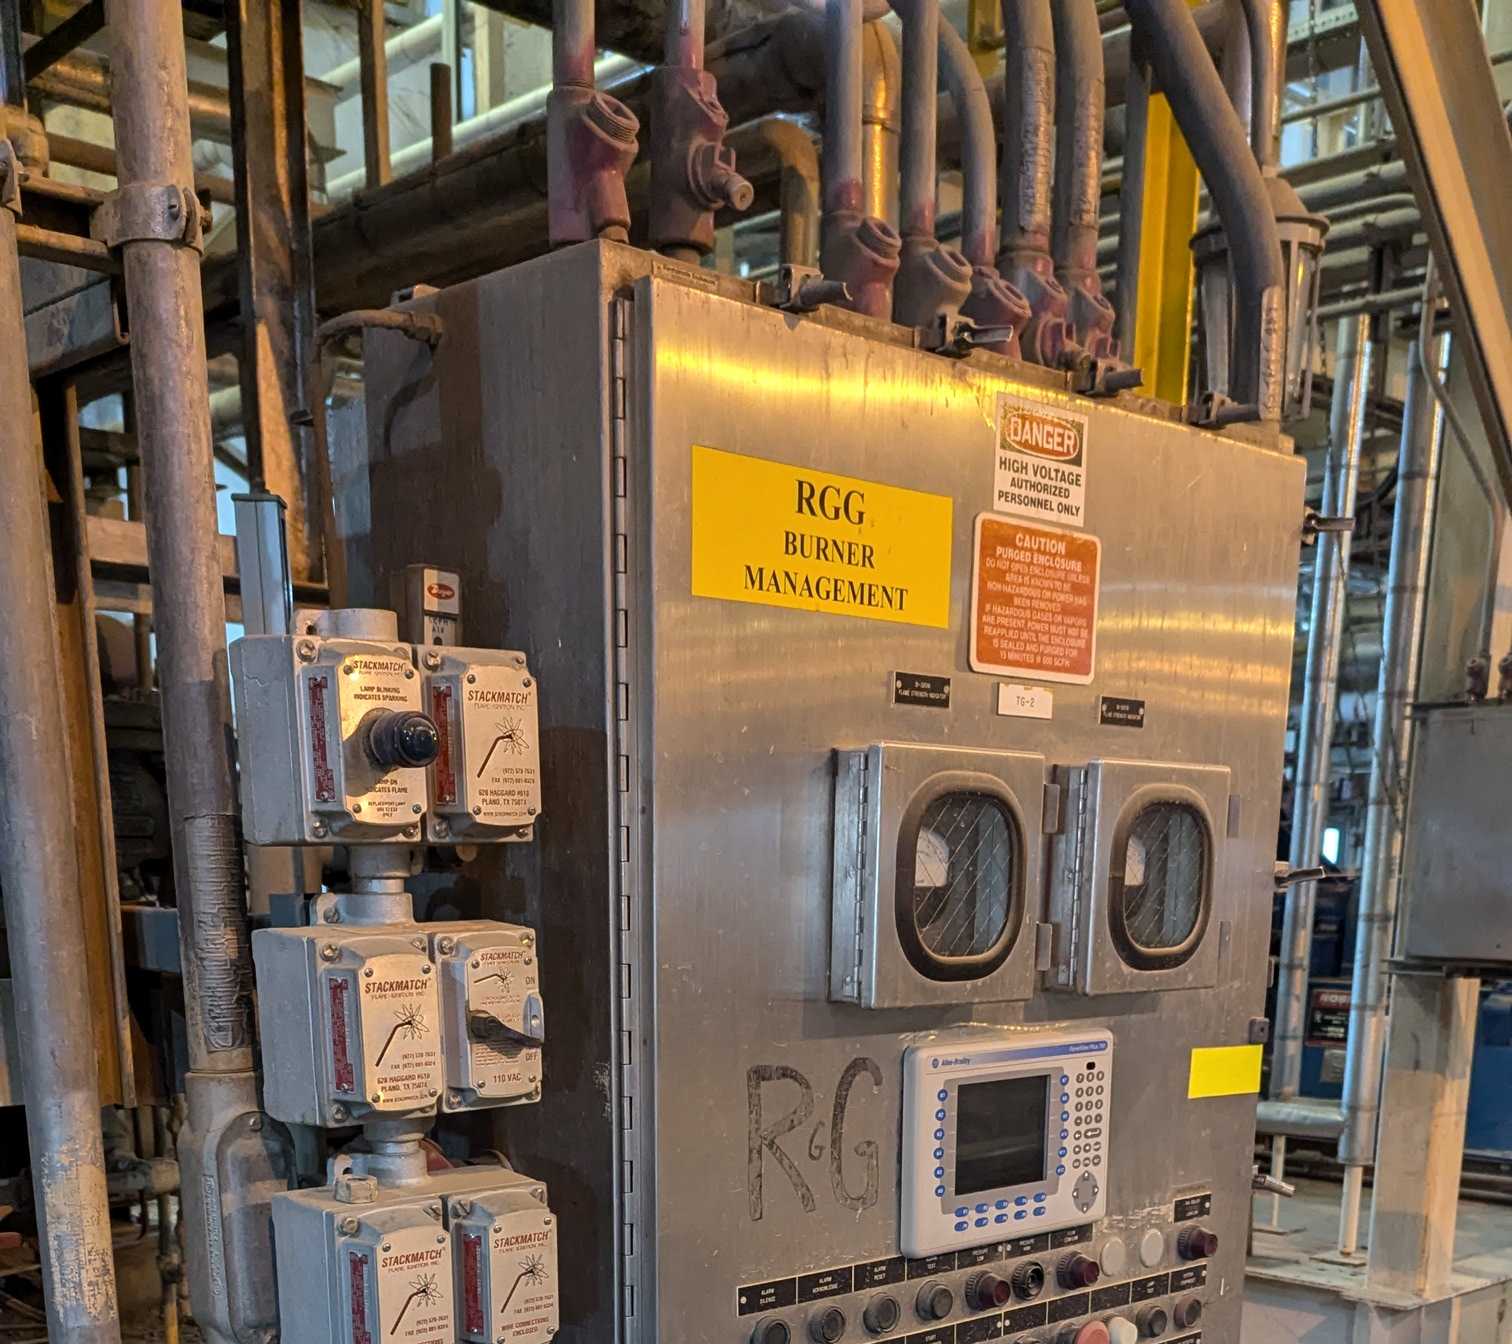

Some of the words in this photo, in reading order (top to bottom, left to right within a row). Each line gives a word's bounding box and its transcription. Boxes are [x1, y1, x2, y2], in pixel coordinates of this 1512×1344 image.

[1010, 416, 1075, 454] DANGER
[999, 456, 1028, 475] HIGH
[1032, 463, 1082, 487] VOLTAGE
[1010, 477, 1070, 500] AUTHORIZED
[795, 479, 866, 526] RGG
[998, 490, 1054, 512] PERSONNEL
[1057, 502, 1080, 517] ONLY
[784, 530, 875, 569] BURNER
[1016, 533, 1066, 556] CAUTION
[996, 546, 1032, 563] PURGED
[1032, 552, 1082, 572] ENCLOSURE
[744, 564, 908, 612] MANAGEMENT
[353, 660, 405, 672] STACKMATCH
[467, 689, 529, 704] STACKMATCH
[1016, 696, 1036, 708] TG-2
[480, 951, 525, 962] STACKMATCH
[365, 979, 428, 994] STACKMATCH
[493, 1074, 506, 1084] 110
[507, 1072, 522, 1082] VAC
[494, 1231, 549, 1250] STACKMATCH
[381, 1249, 442, 1268] STACKMATCH
